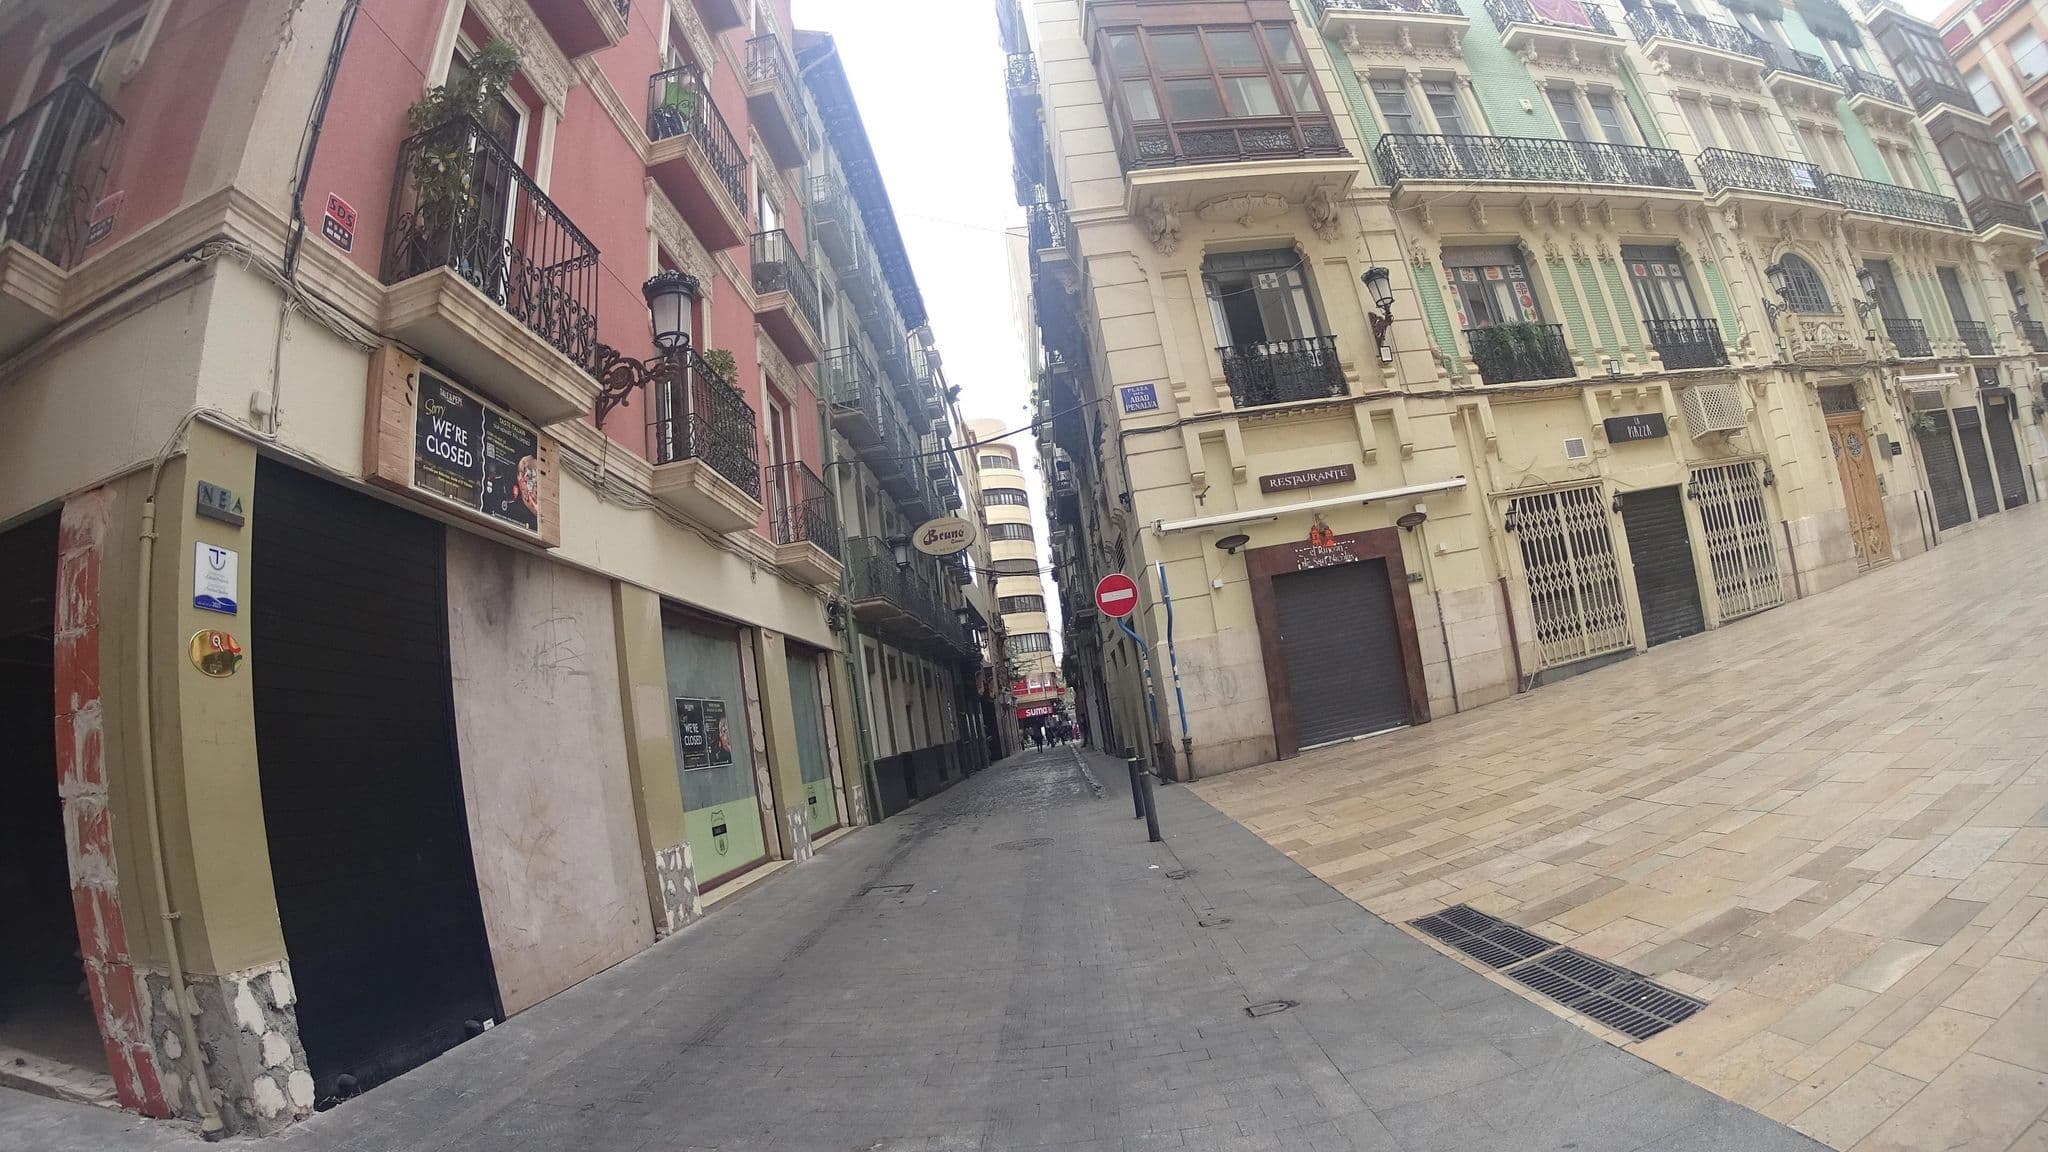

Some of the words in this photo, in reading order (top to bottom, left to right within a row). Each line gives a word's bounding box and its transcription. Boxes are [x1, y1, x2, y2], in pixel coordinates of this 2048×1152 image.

[1129, 395, 1150, 404] ABAD
[432, 415, 468, 447] WE'RE
[426, 434, 473, 468] CLOSED
[1269, 468, 1349, 488] RESTAURANTE
[200, 485, 243, 514] NEA
